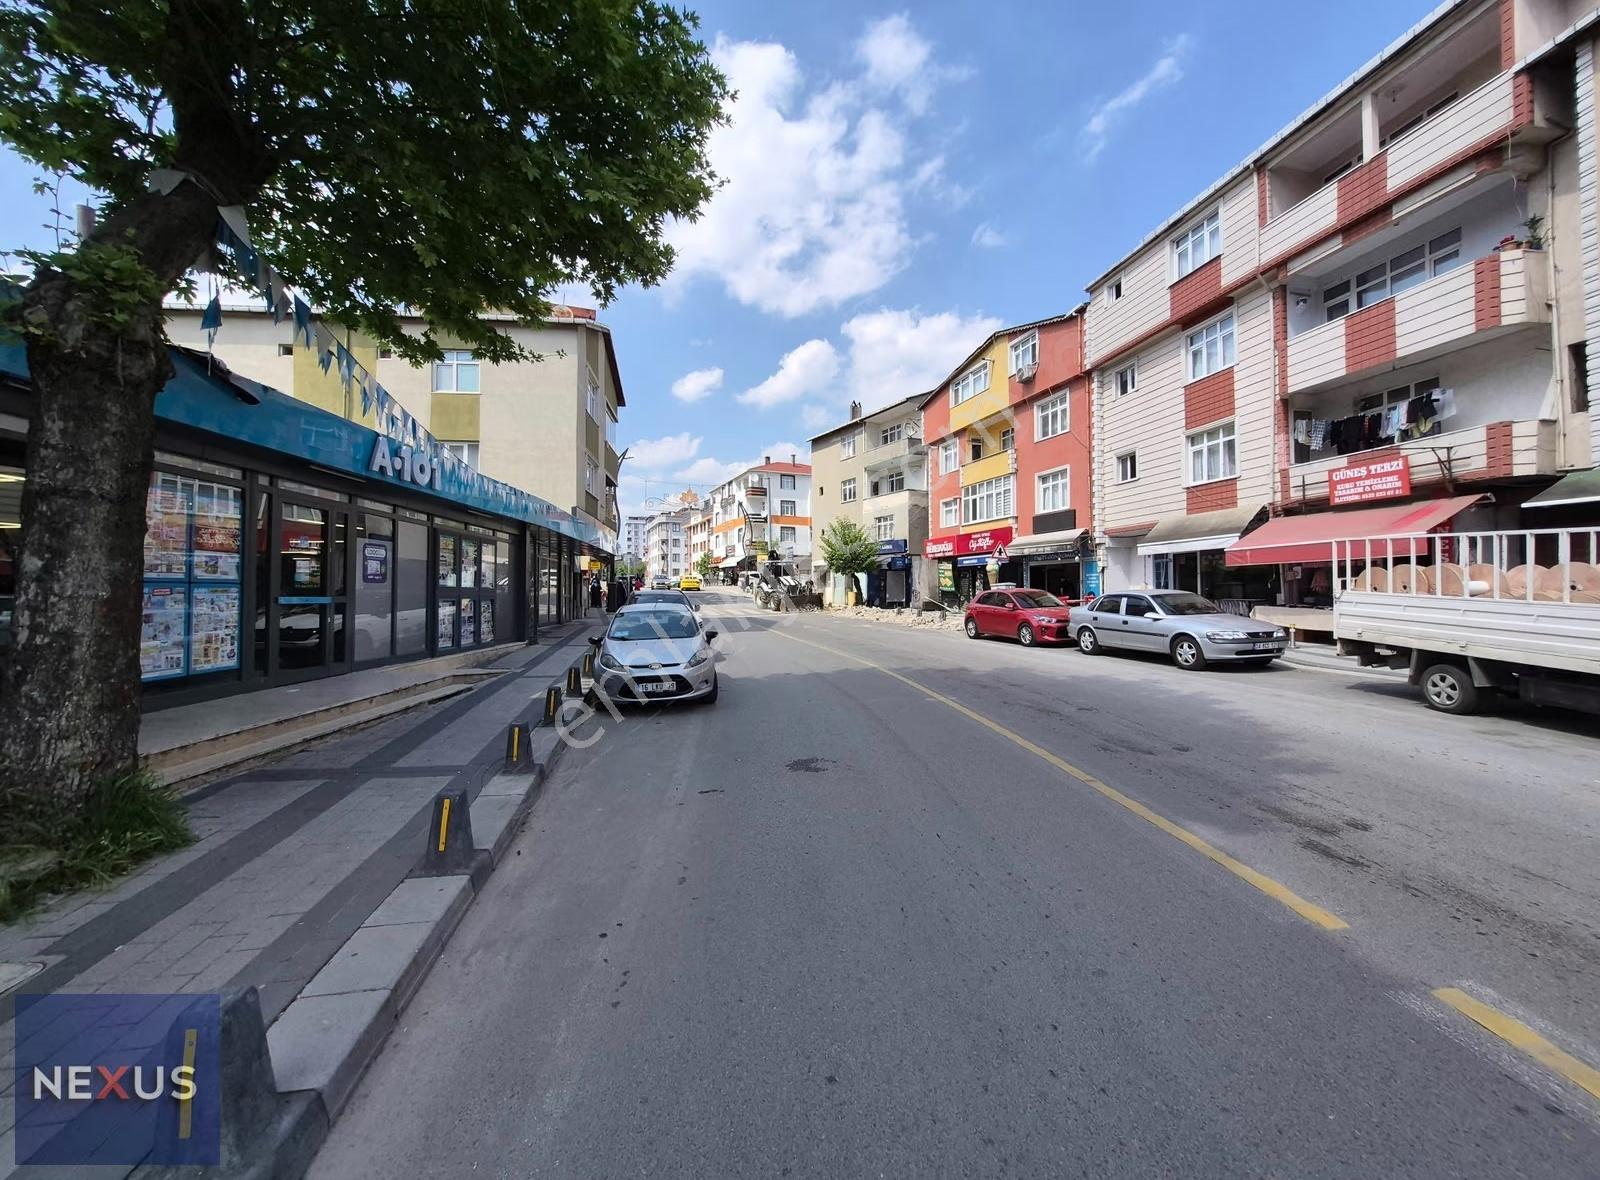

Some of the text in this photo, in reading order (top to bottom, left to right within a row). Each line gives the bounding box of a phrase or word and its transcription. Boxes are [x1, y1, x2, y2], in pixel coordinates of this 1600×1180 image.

[1332, 458, 1404, 481] GÜNEŞ TERZİ
[1333, 486, 1364, 497] TASARIM
